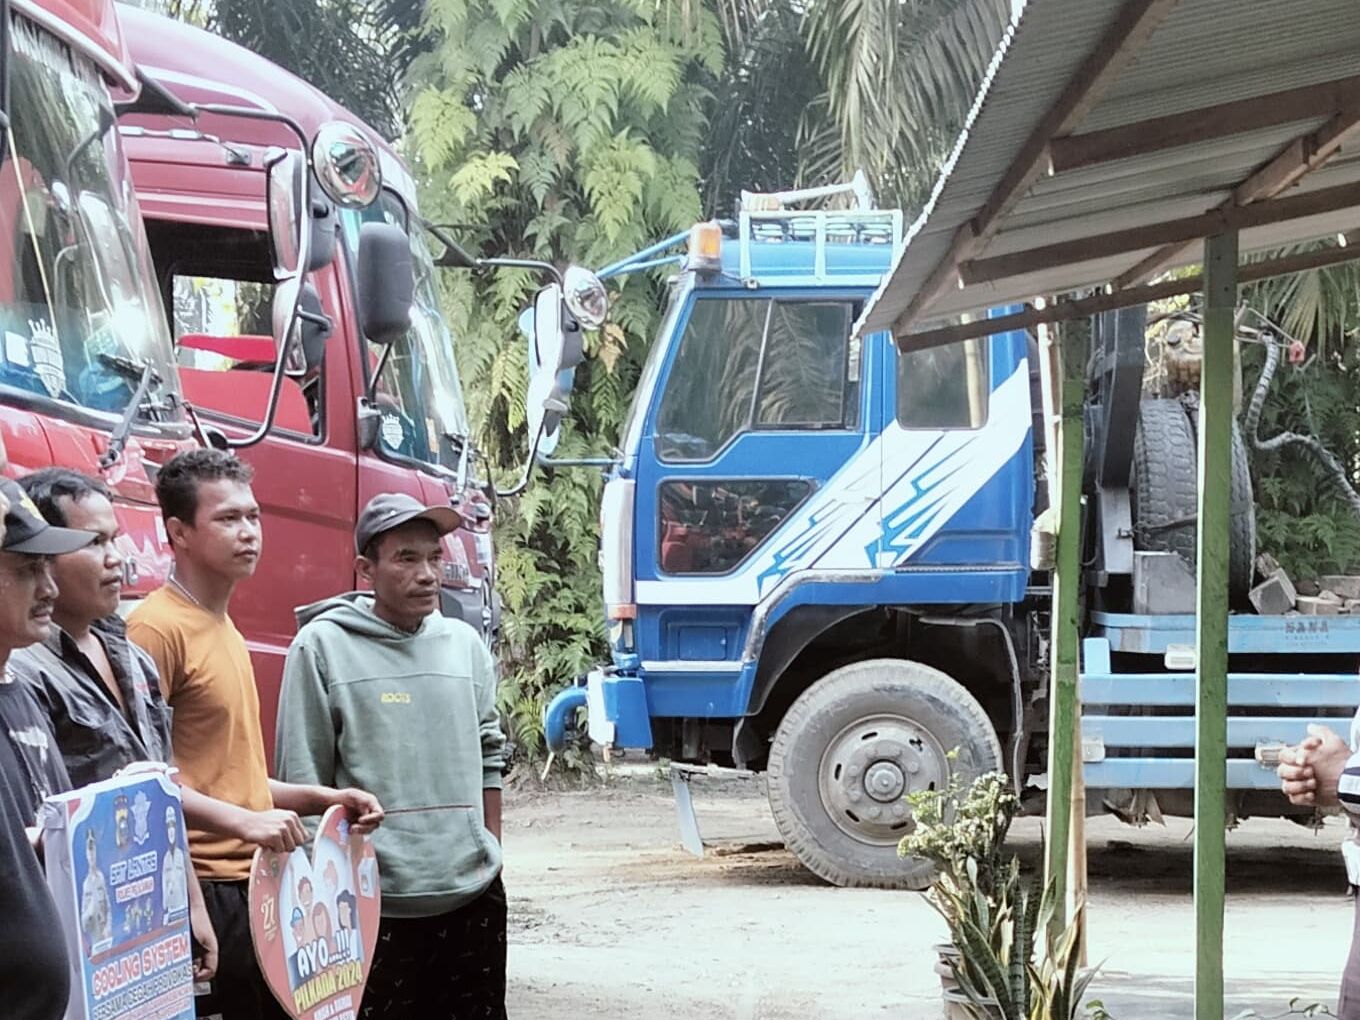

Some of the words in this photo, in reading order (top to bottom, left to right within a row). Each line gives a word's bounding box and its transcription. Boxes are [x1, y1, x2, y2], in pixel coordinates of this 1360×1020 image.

[92, 952, 141, 999] COOLING
[142, 931, 189, 976] SYSTEM
[294, 970, 337, 1015] PILKADA
[336, 960, 363, 994] 2024
